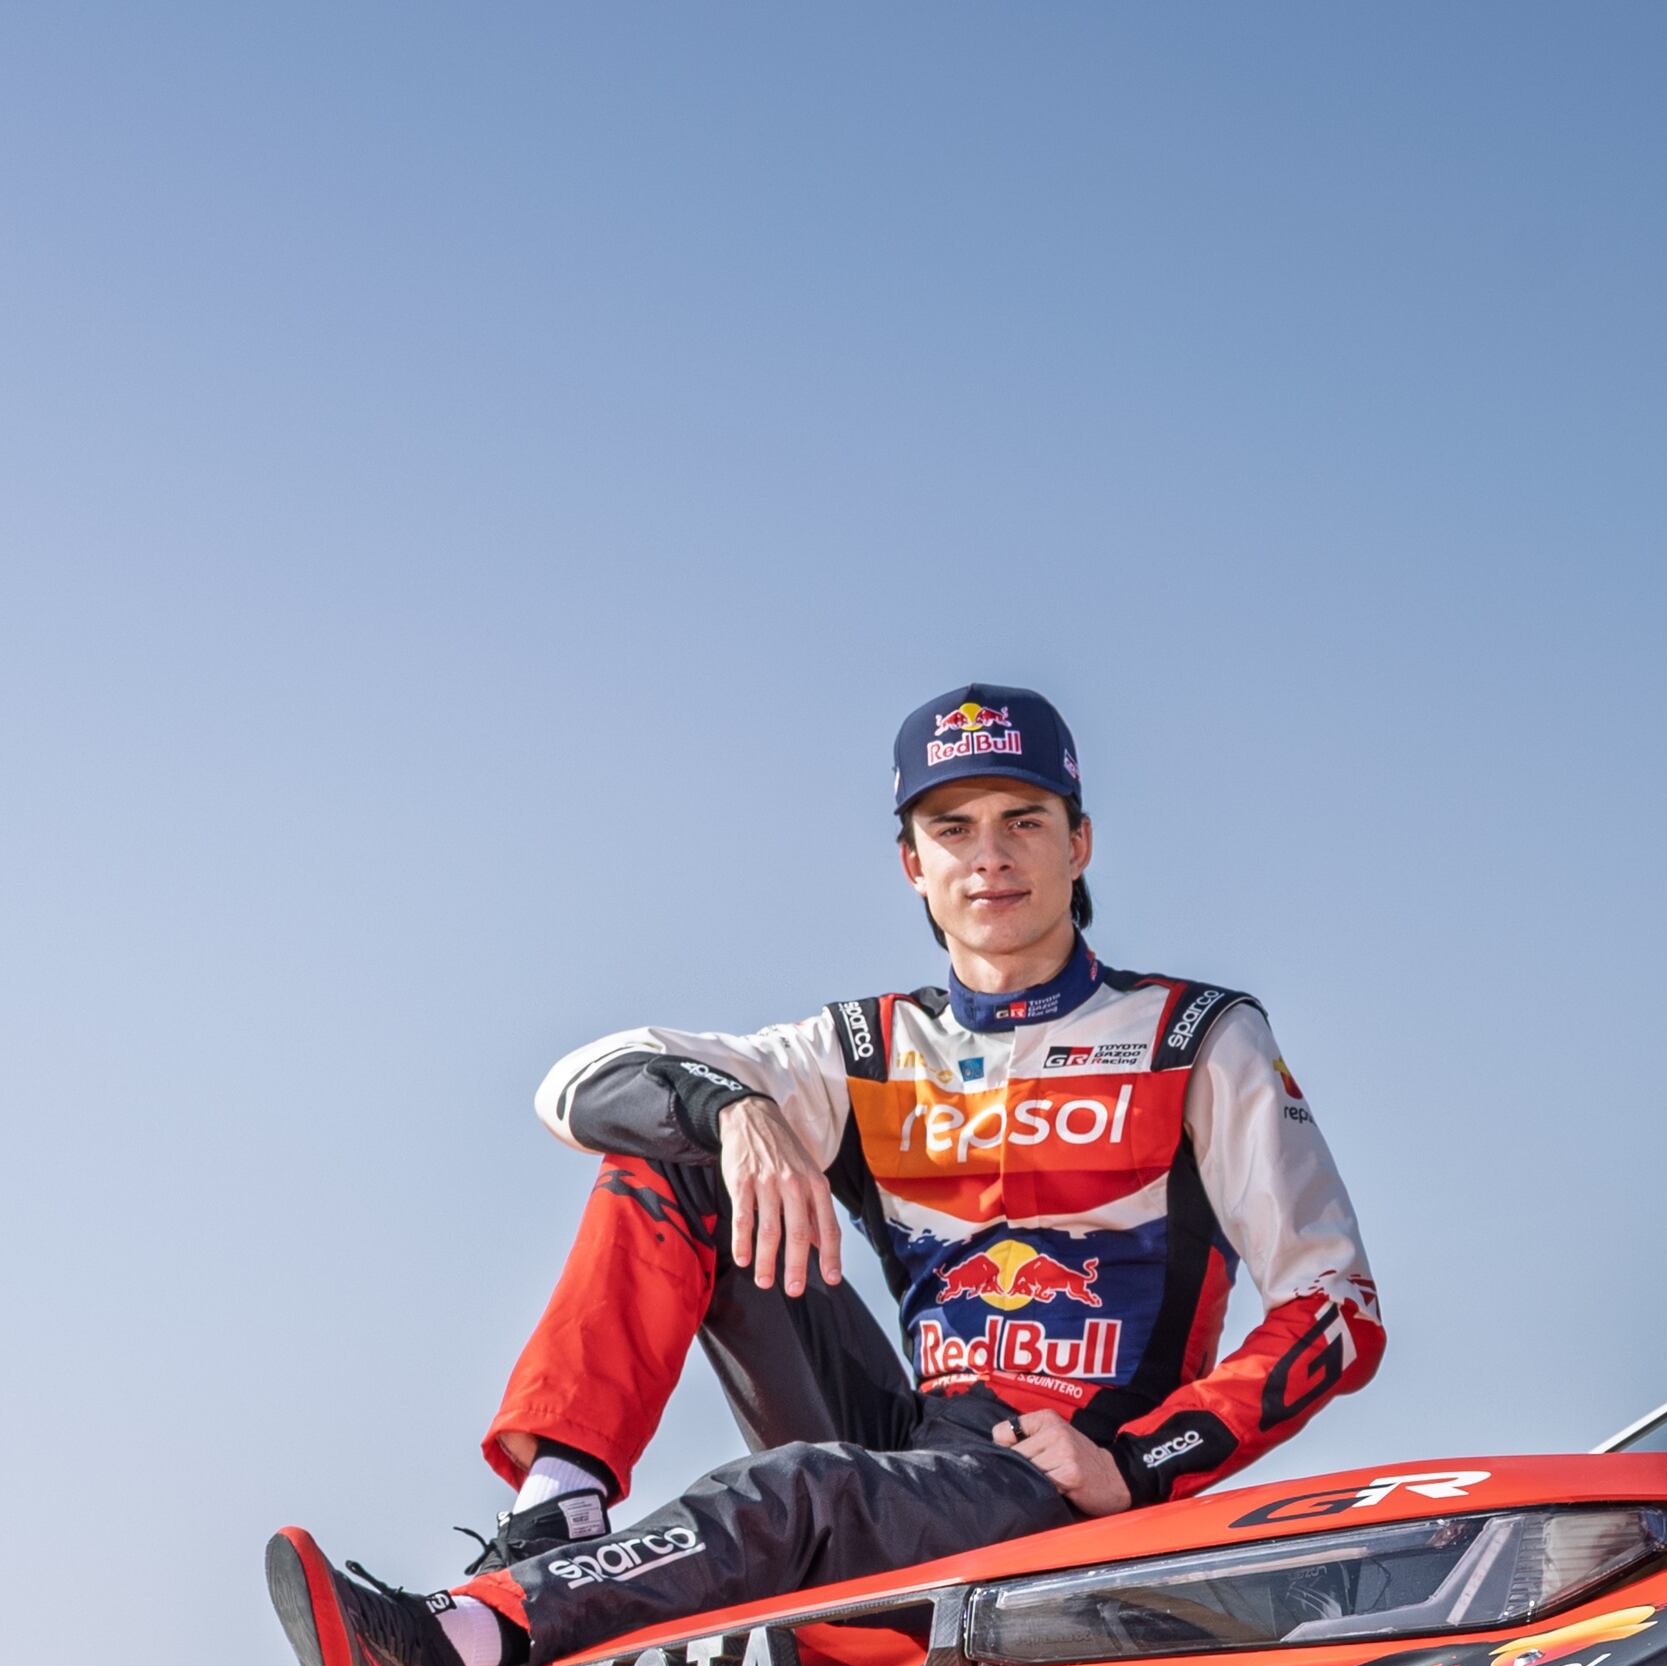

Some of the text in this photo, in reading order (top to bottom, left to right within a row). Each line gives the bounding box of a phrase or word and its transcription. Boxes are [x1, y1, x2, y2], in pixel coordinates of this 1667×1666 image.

[927, 730, 1022, 766] Red Bull
[996, 1006, 1026, 1020] GR
[1167, 990, 1224, 1050] sparco
[1045, 1053, 1090, 1069] GR
[1091, 1057, 1137, 1066] Racing
[1097, 1043, 1148, 1052] TOYOTA
[900, 1084, 1133, 1163] repsol
[1284, 1105, 1314, 1124] rep
[919, 1315, 1122, 1378] Red Bull
[1017, 1372, 1083, 1399] S.QUINTERO
[1226, 1471, 1491, 1529] GR
[548, 1527, 706, 1590] sparco
